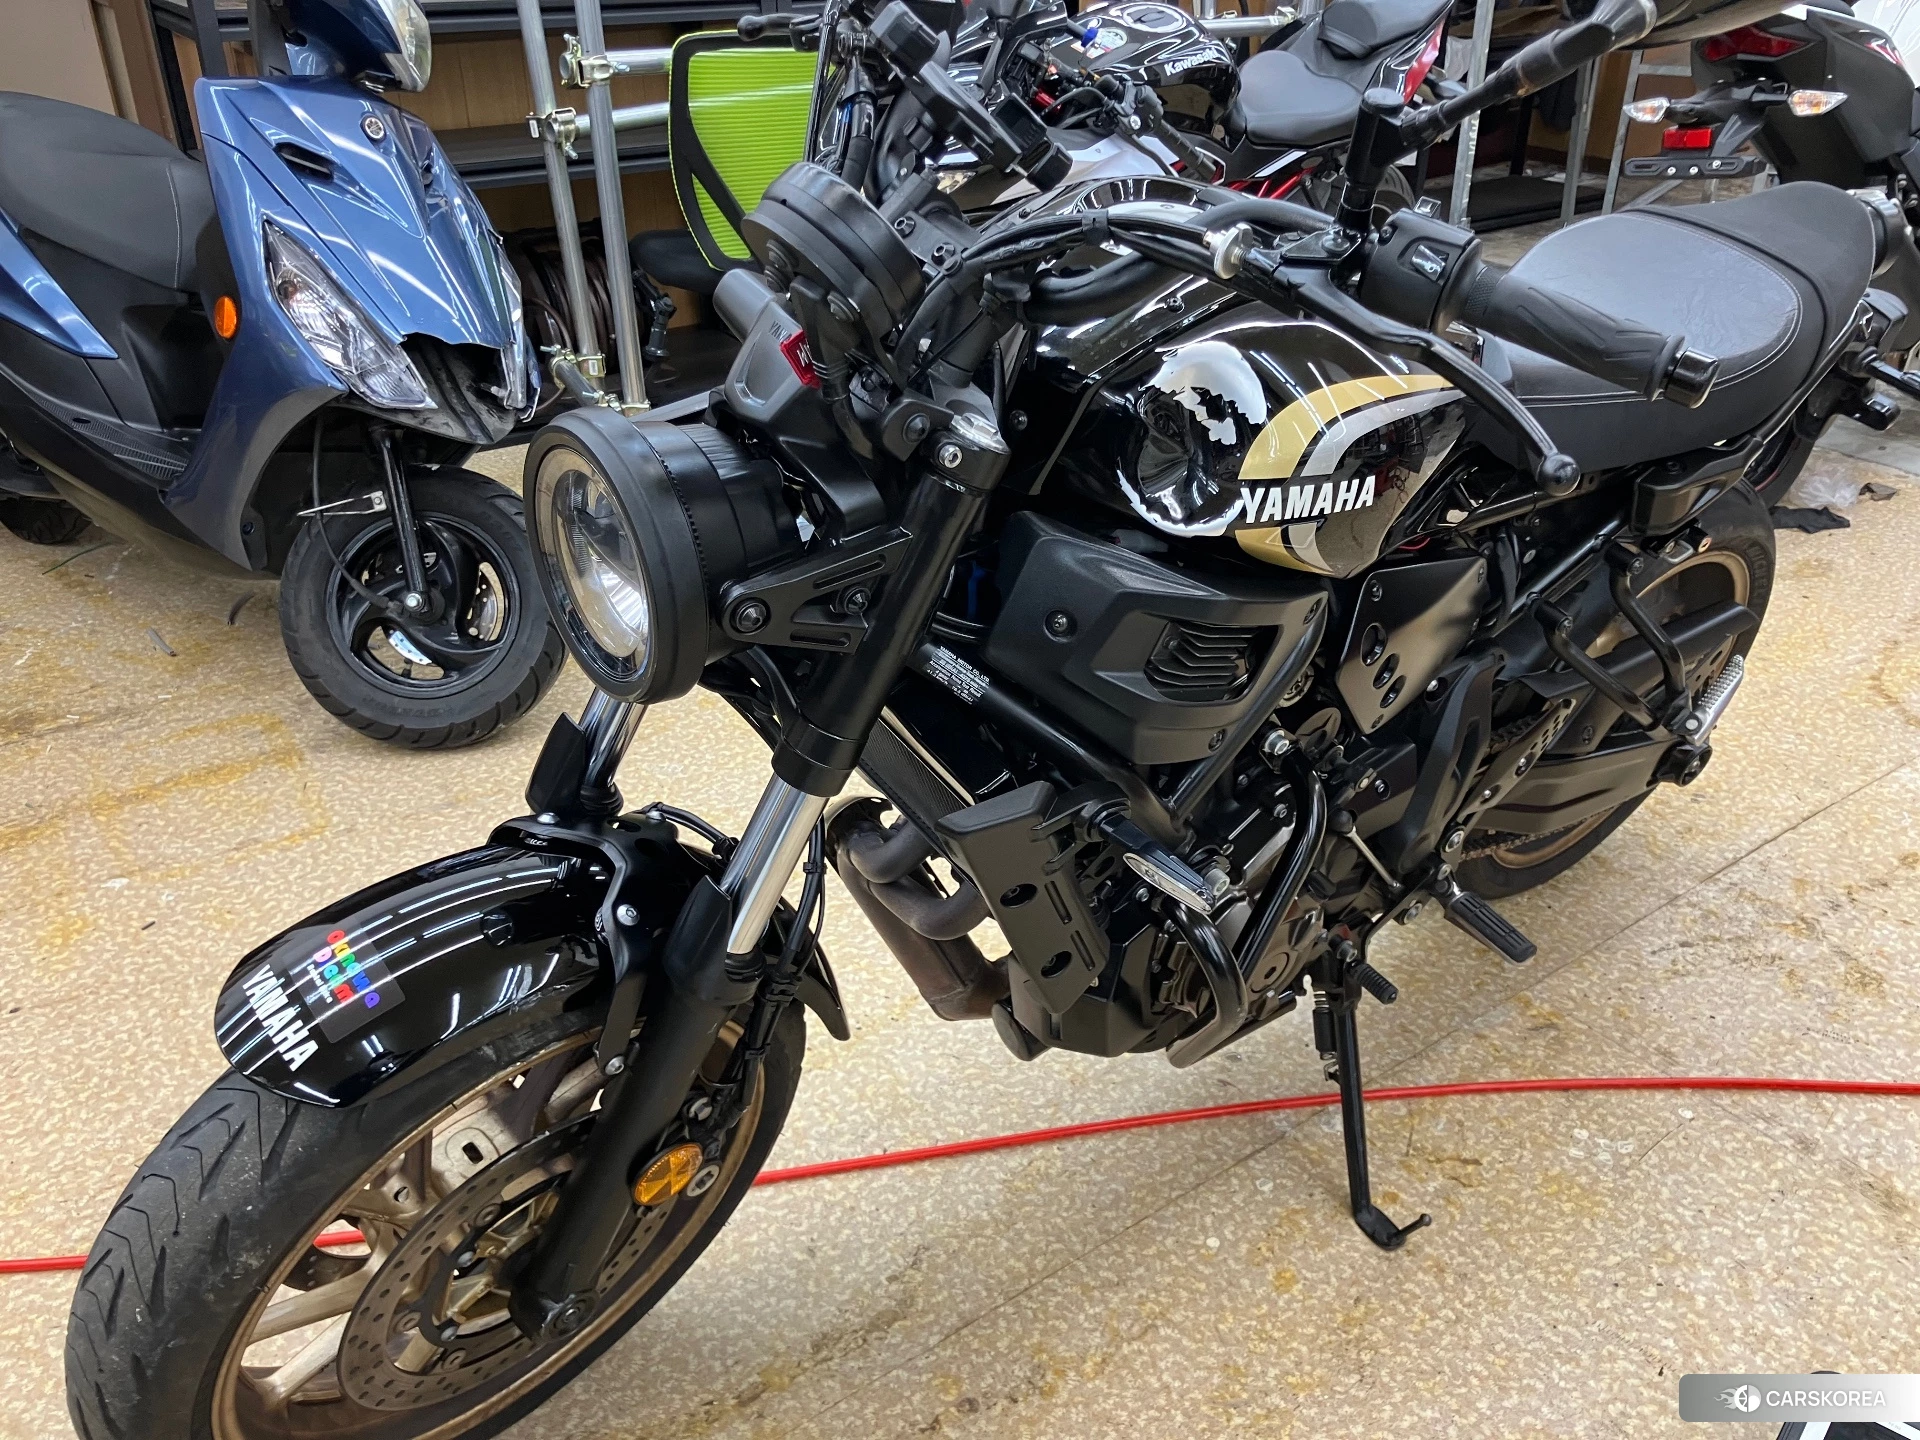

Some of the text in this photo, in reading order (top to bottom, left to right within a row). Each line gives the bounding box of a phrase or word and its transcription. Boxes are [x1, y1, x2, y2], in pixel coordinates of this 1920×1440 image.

[1163, 47, 1218, 77] Kawasaki
[1240, 475, 1376, 524] YAMAHA
[940, 645, 957, 659] YAMAHA
[957, 658, 973, 670] MOTOR
[242, 964, 318, 1071] YAMAHA
